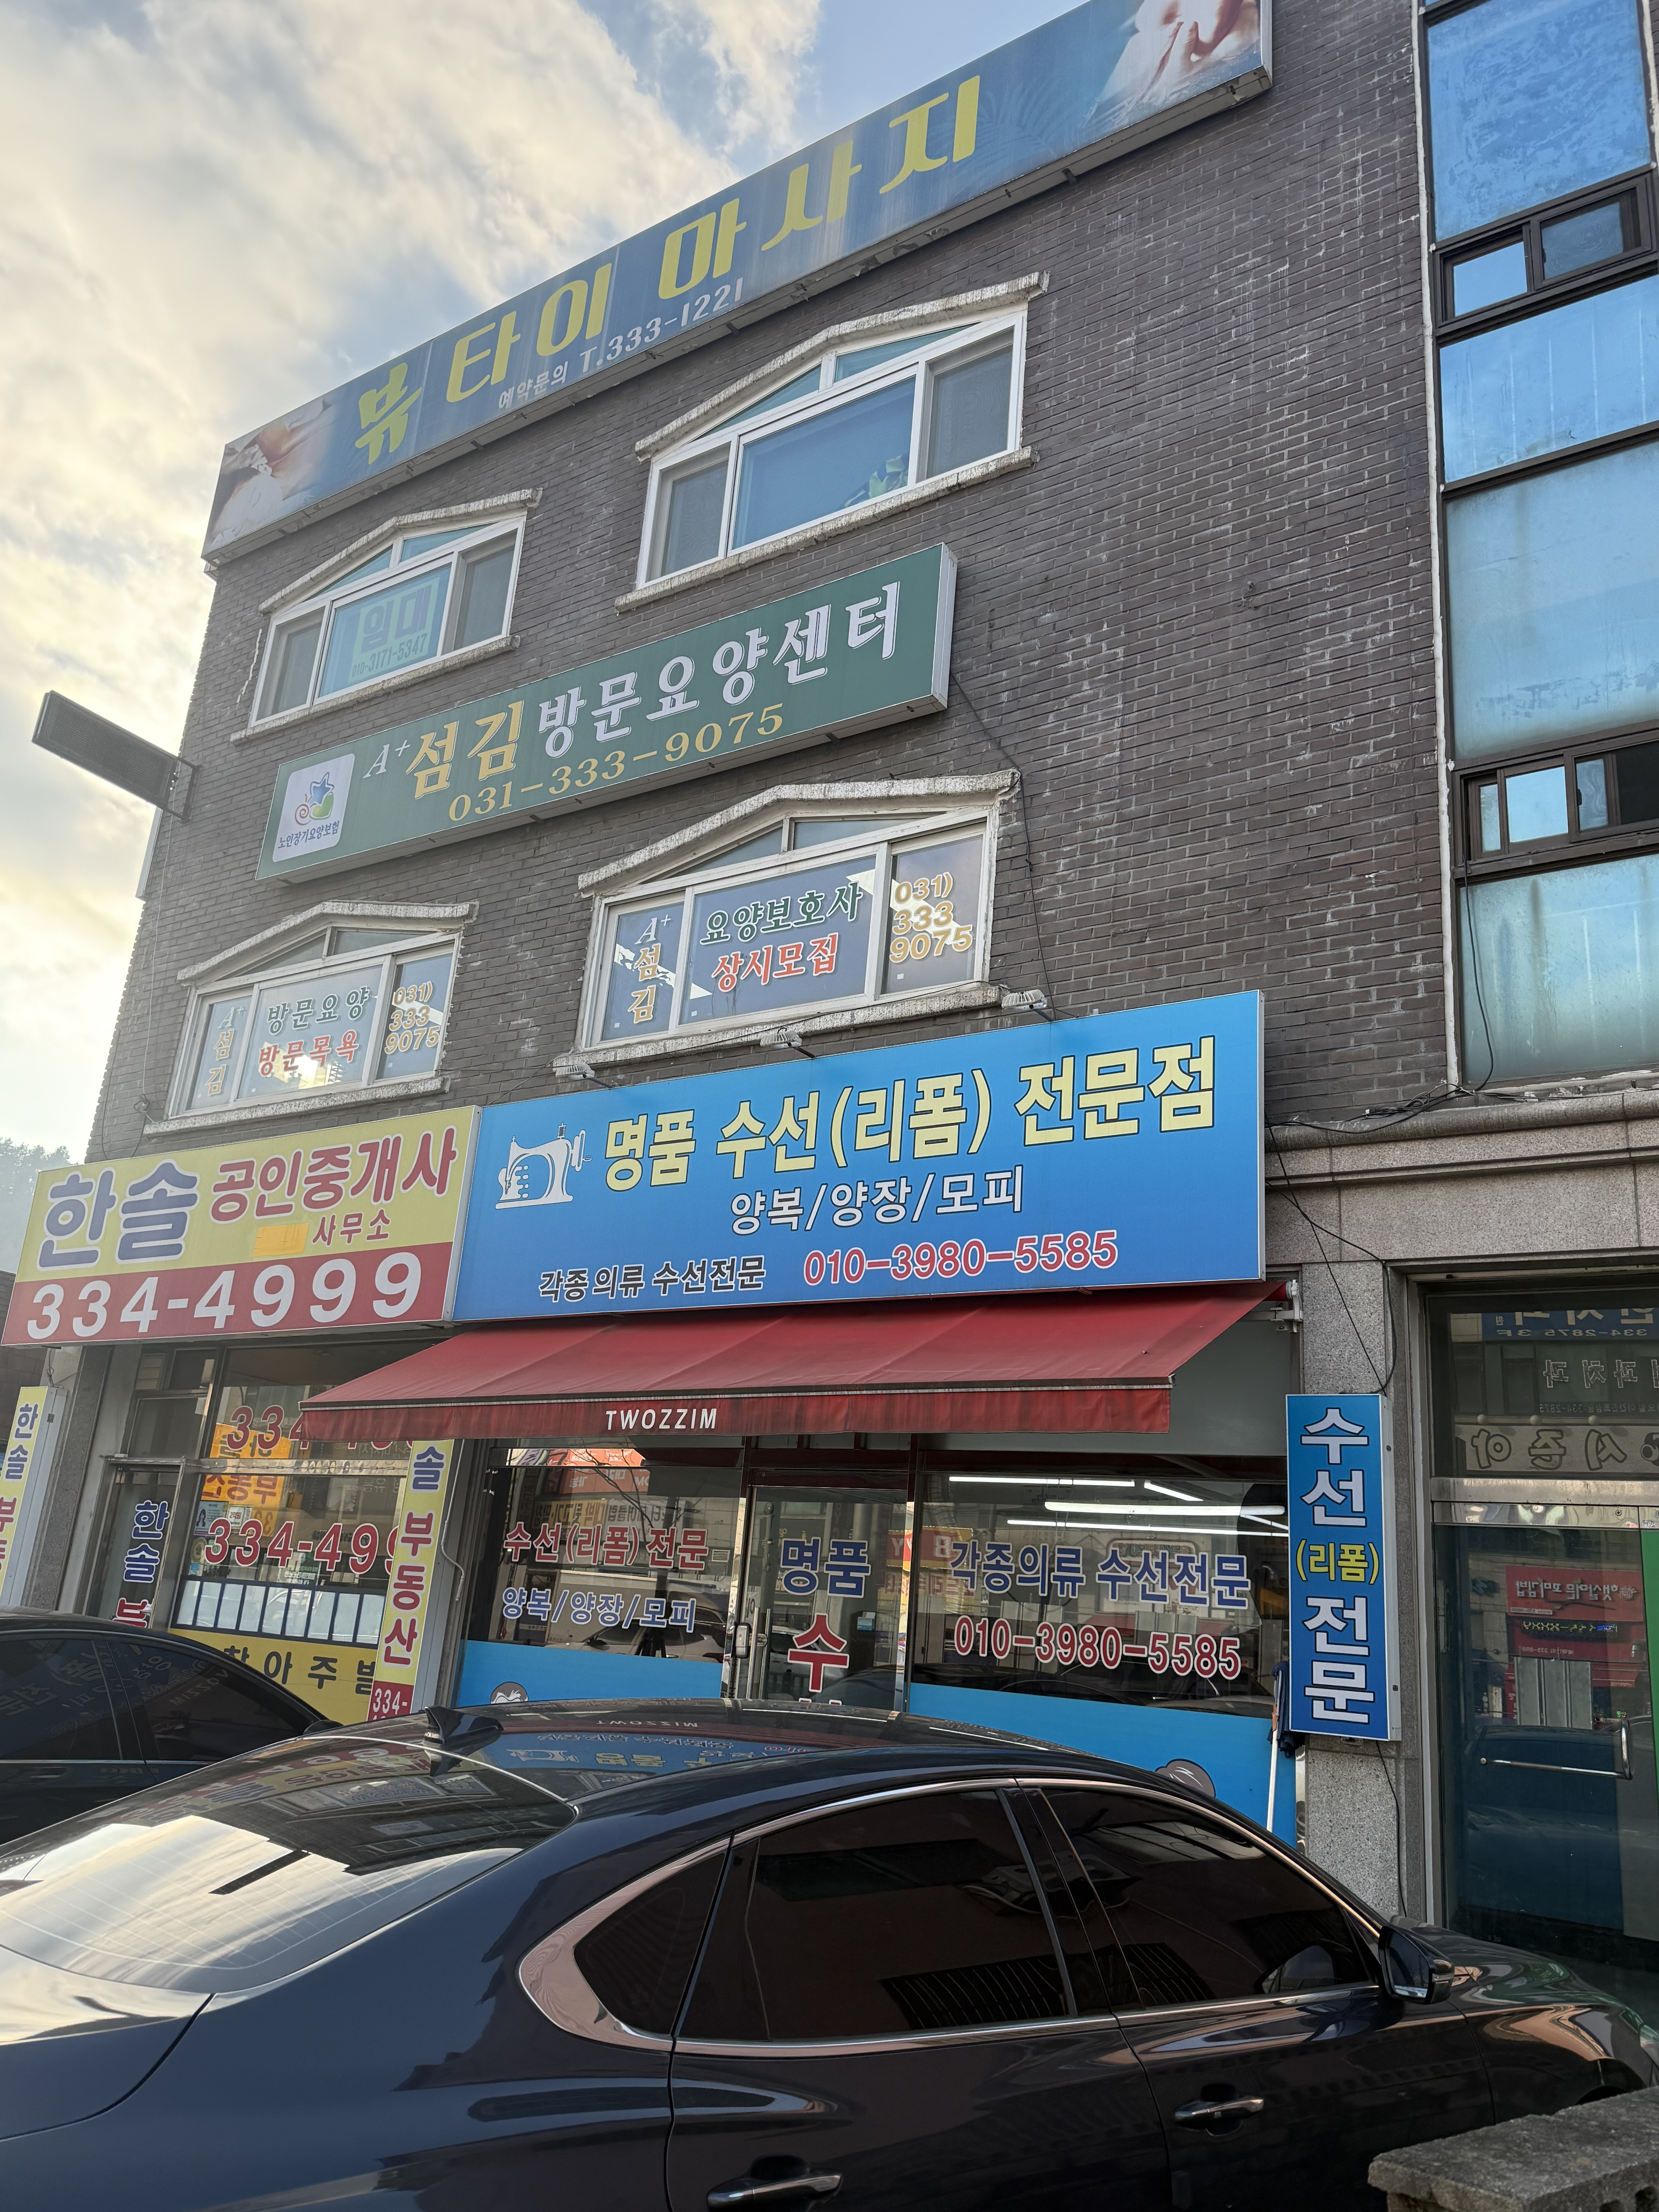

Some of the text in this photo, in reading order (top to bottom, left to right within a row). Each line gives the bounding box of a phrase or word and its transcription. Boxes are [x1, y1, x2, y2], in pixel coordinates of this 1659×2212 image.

[659, 76, 981, 299] 마사지
[499, 361, 568, 409] 예약문의
[361, 584, 433, 653] 임대
[352, 633, 428, 677] 010-3171-5347
[450, 703, 783, 821] 031-333-9075
[278, 821, 340, 849] 노인장기요양보험
[894, 872, 953, 905] 031)
[700, 881, 864, 945] 요양보호사
[893, 900, 954, 936] 333
[711, 933, 839, 993] 상시모집
[889, 924, 974, 964] 9075
[268, 986, 370, 1035] 방문요양
[393, 981, 433, 1005] 031)
[384, 1025, 441, 1055] 9075
[389, 1006, 430, 1032] 333
[258, 1030, 359, 1078] 방문목욕
[605, 1035, 1215, 1192] 명품 수선(리폼) 전문점
[36, 1125, 458, 1272] 한솔 공인중개사
[731, 1164, 1024, 1236] 양복/양장/모피
[312, 1209, 392, 1247] 사무소
[653, 1255, 766, 1296] 수선전문
[804, 1229, 1118, 1286] 010-3980-5585
[27, 1252, 422, 1340] 334-4999
[606, 1408, 718, 1431] TWOZZIM
[646, 1527, 709, 1571] 전문
[780, 1537, 871, 1598] 명품
[1296, 1539, 1380, 1585] (리폼)
[950, 1539, 1085, 1599] 각종의류
[1095, 1548, 1251, 1610] 수선전문
[503, 1587, 697, 1633] 양복/양장/모피
[787, 1613, 850, 1705] 수
[954, 1615, 1242, 1680] 010-3980-5585
